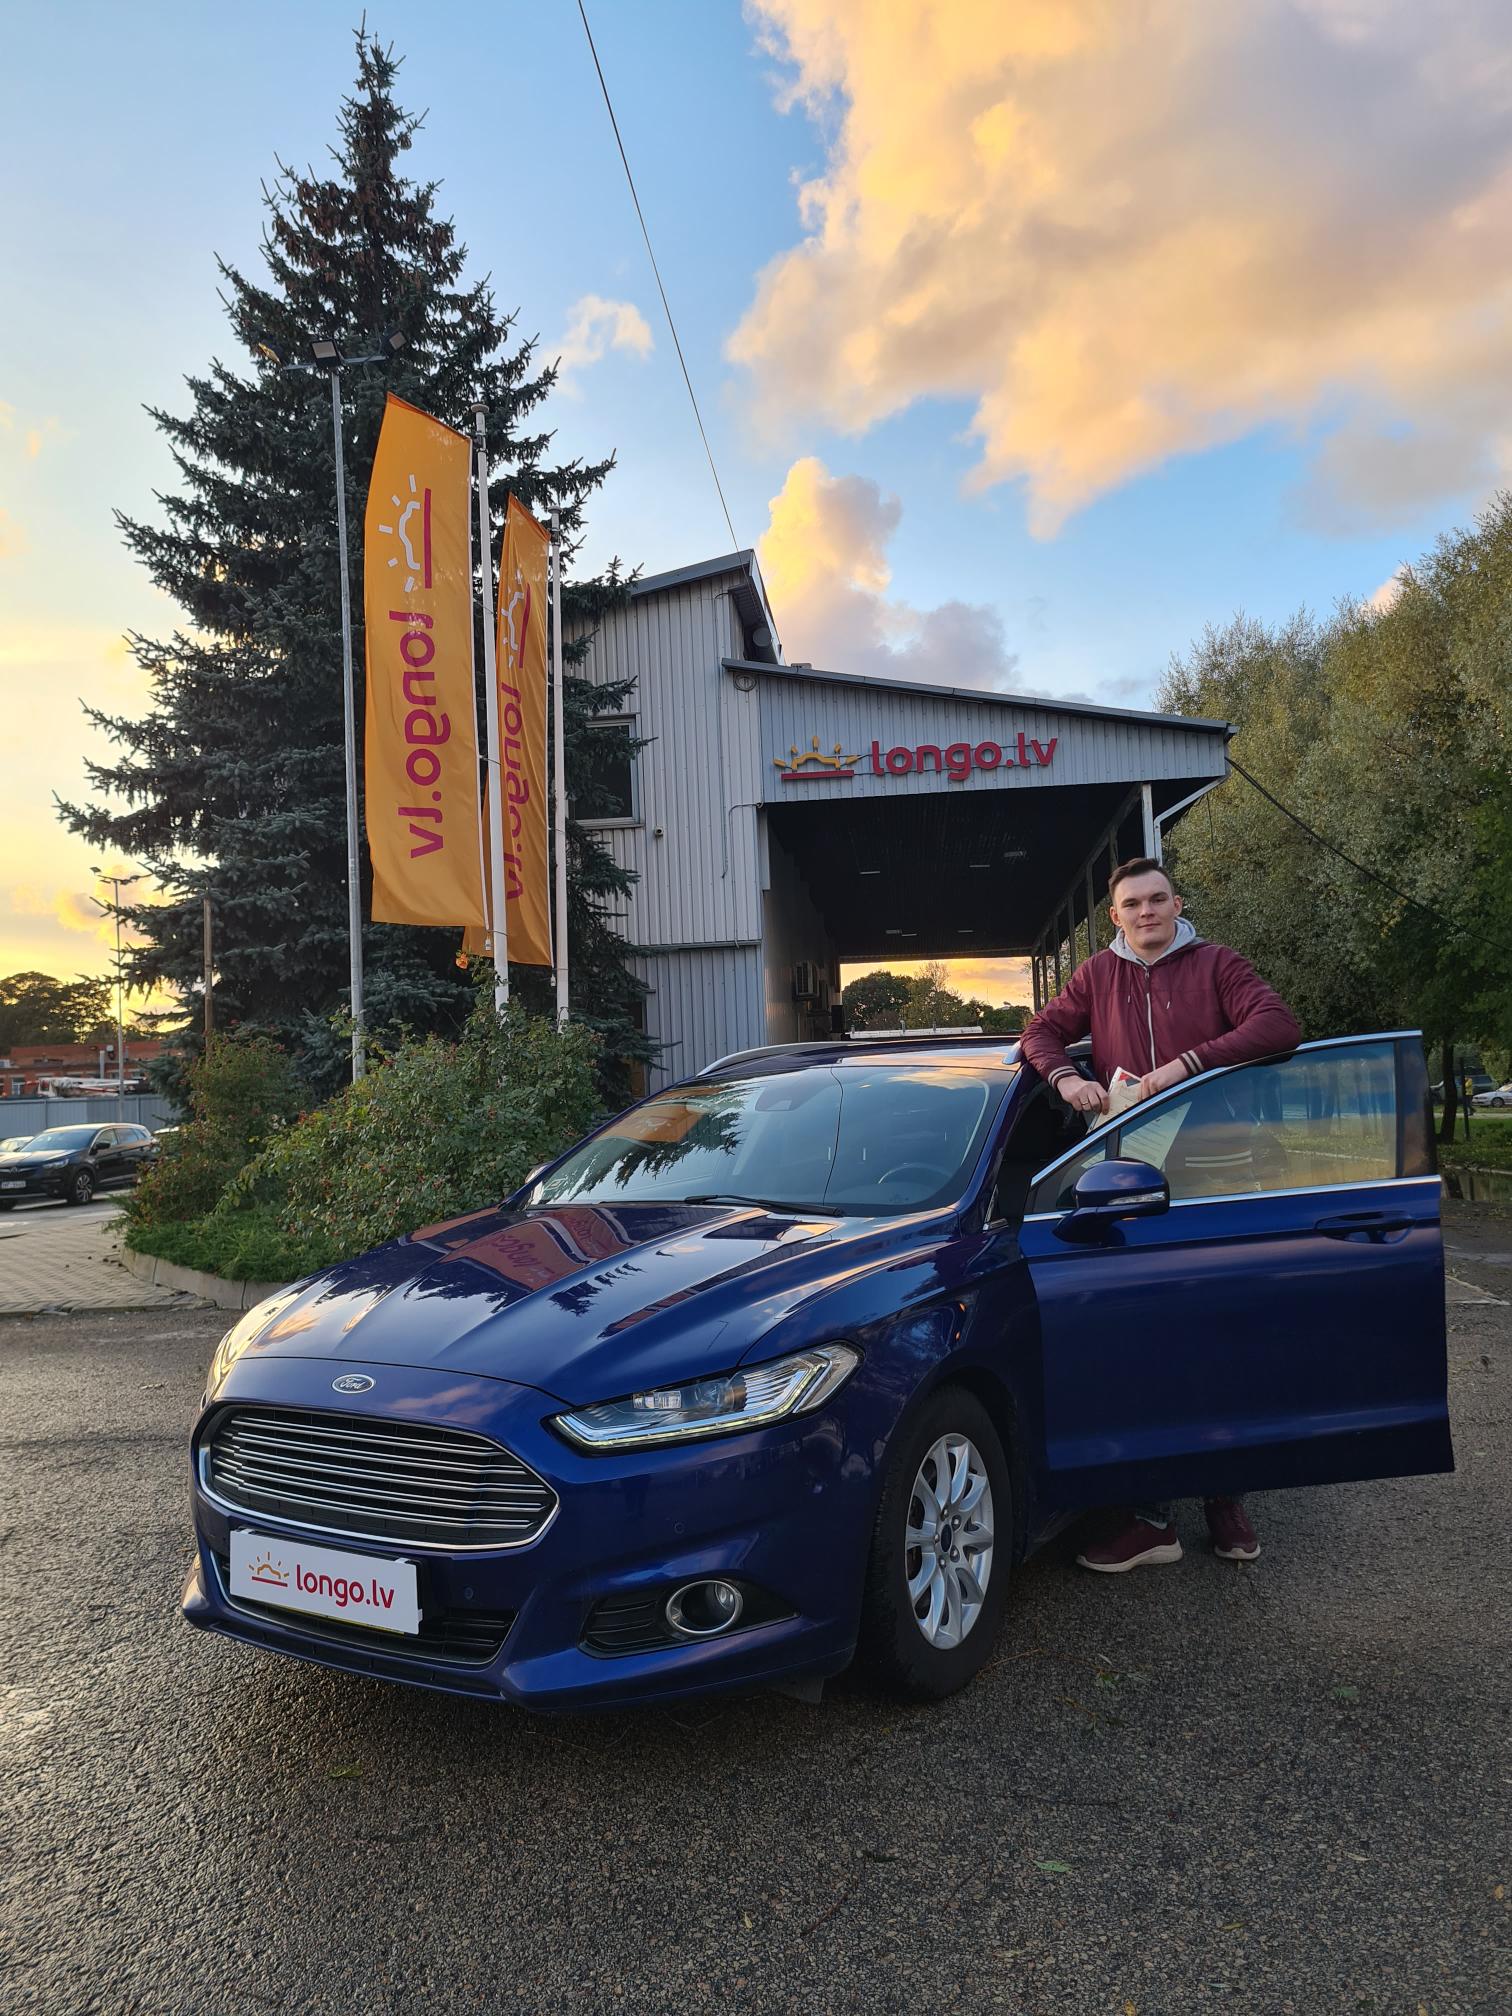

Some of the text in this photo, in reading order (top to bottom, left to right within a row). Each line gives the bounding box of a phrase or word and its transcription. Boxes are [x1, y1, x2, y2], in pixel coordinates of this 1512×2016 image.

[871, 732, 1058, 781] longo.lv
[338, 1376, 368, 1390] Ford
[296, 1564, 395, 1609] longo.lv
